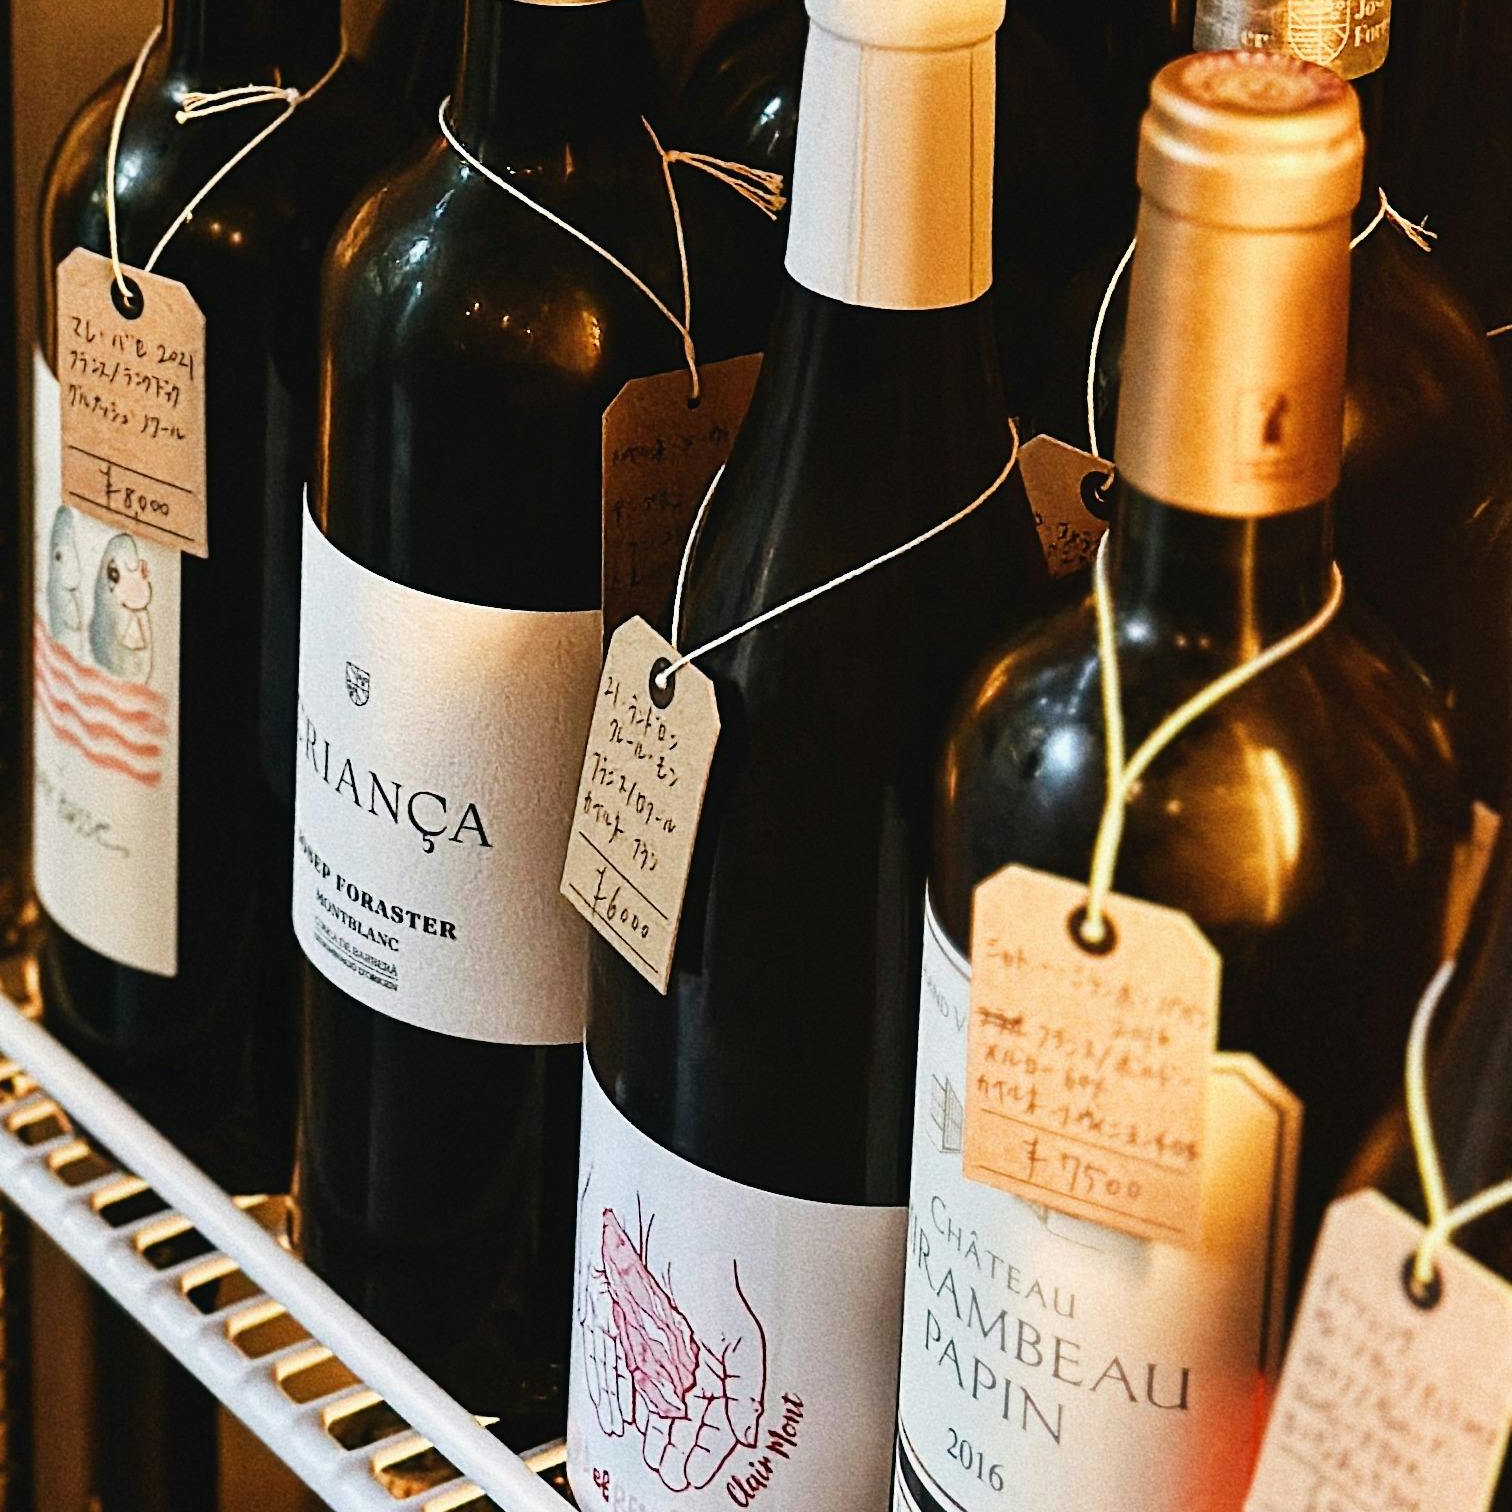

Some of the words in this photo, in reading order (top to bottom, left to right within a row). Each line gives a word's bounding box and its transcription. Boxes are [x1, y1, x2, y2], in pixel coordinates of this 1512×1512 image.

[156, 343, 195, 381] 2021
[298, 701, 494, 854] RIANÇA
[315, 887, 400, 953] MONTBLANC
[336, 874, 459, 941] FORASTER
[1023, 1135, 1143, 1199] ¥7500
[931, 1195, 1076, 1320] CHÂTEAU
[924, 1308, 1064, 1446] PAPIN
[765, 1391, 805, 1460] Mont
[946, 1427, 1006, 1493] 2016
